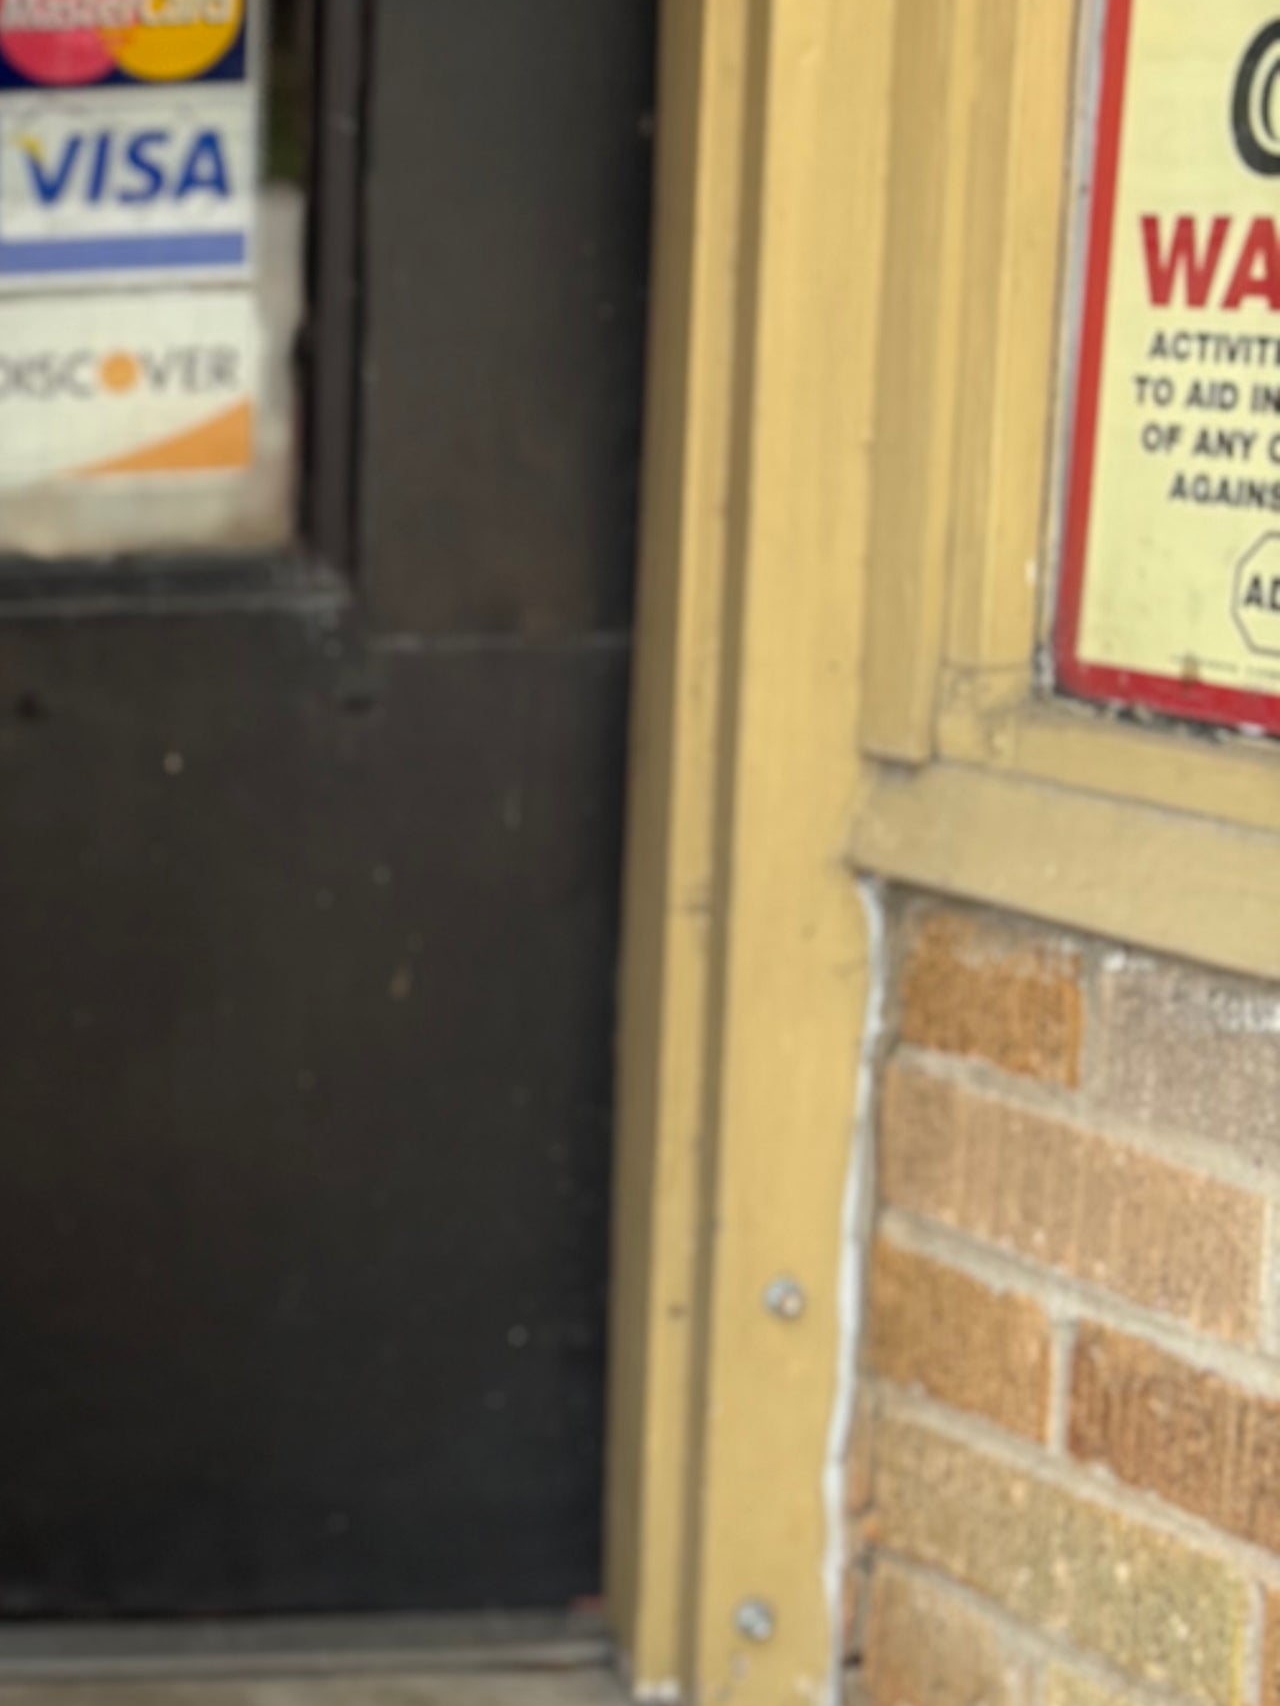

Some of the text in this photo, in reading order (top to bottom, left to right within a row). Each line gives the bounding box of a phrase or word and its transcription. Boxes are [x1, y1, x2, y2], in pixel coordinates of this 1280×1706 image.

[13, 128, 231, 206] VISA
[1134, 373, 1175, 409] TO
[1186, 381, 1240, 412] AID
[1140, 421, 1181, 454] OF
[1194, 427, 1256, 462] ANY
